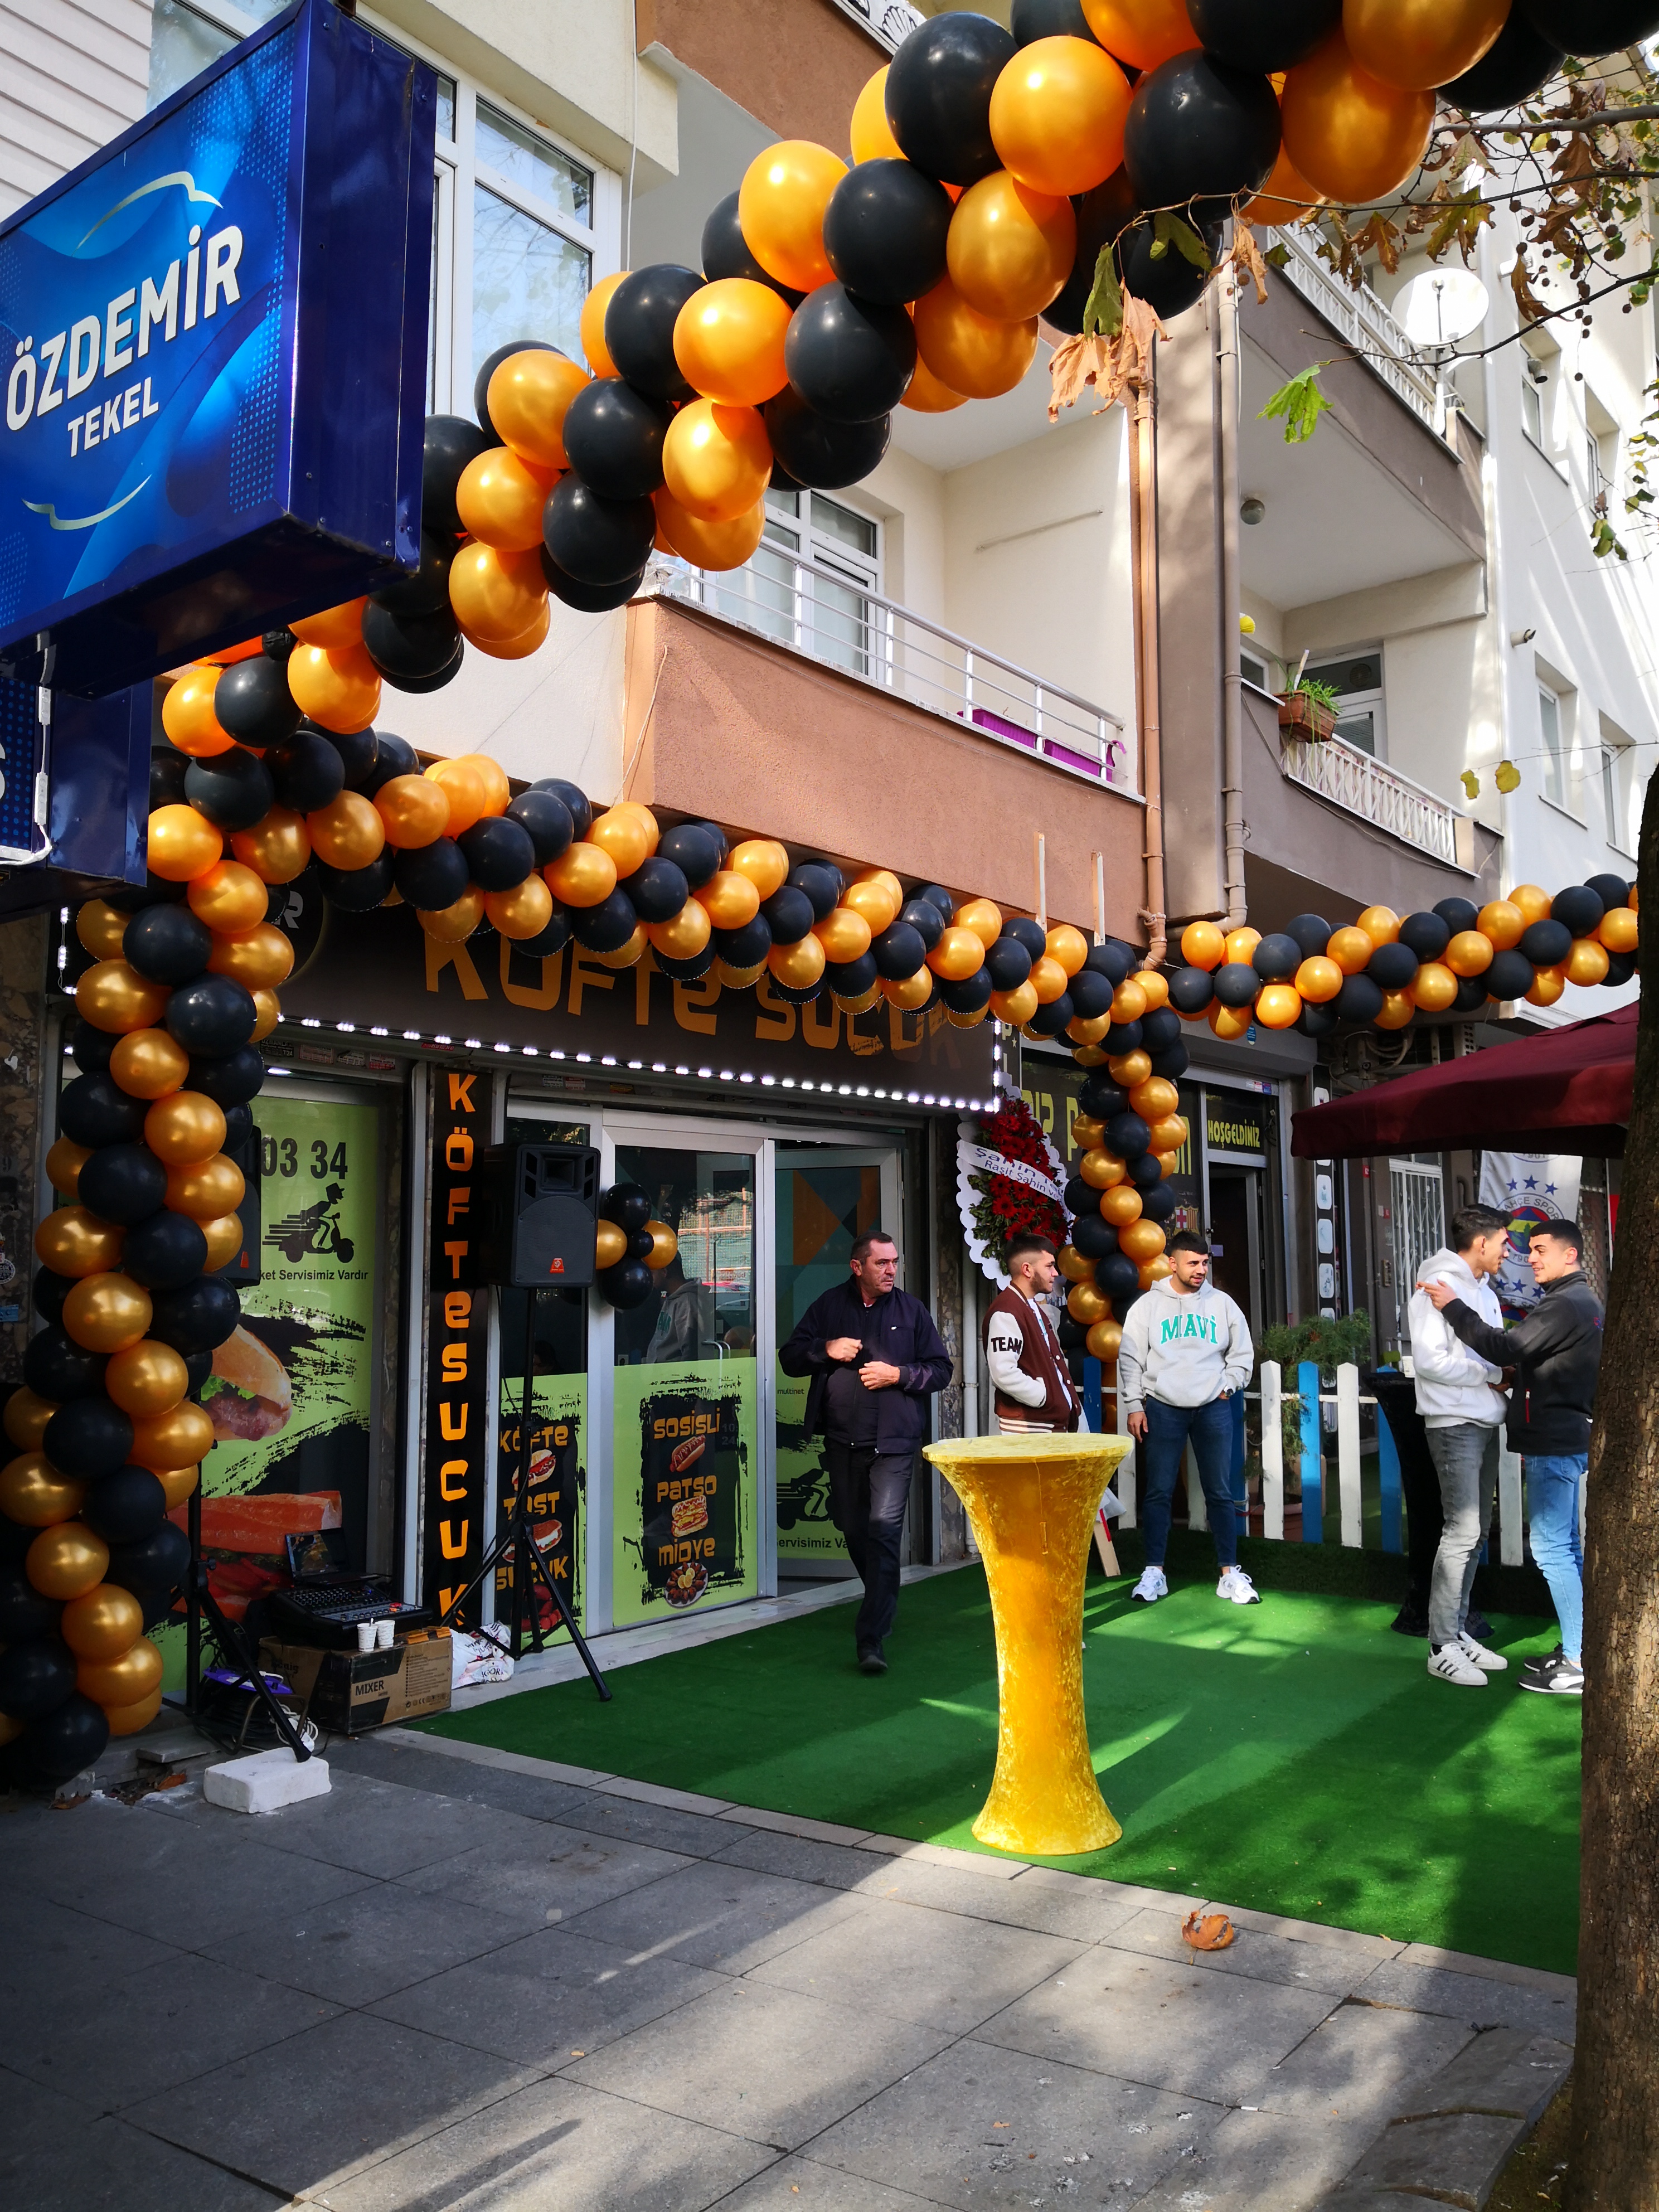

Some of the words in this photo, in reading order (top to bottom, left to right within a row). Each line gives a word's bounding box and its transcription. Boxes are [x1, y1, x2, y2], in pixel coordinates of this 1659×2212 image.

[6, 224, 244, 431] ÖZDEMİR
[67, 377, 159, 458] TEKEL
[1208, 1119, 1260, 1149] HOŞGELDİNİZ
[311, 1140, 348, 1180] 34
[974, 1147, 1036, 1178] Şahin
[984, 1160, 1013, 1178] Raşit
[1017, 1172, 1046, 1192] Şahin
[279, 1269, 335, 1280] Servisimiz
[338, 1270, 369, 1280] Vardır
[1160, 1312, 1218, 1345] MAVİ
[991, 1337, 1022, 1355] TEAM
[356, 1680, 384, 1696] MIXER
